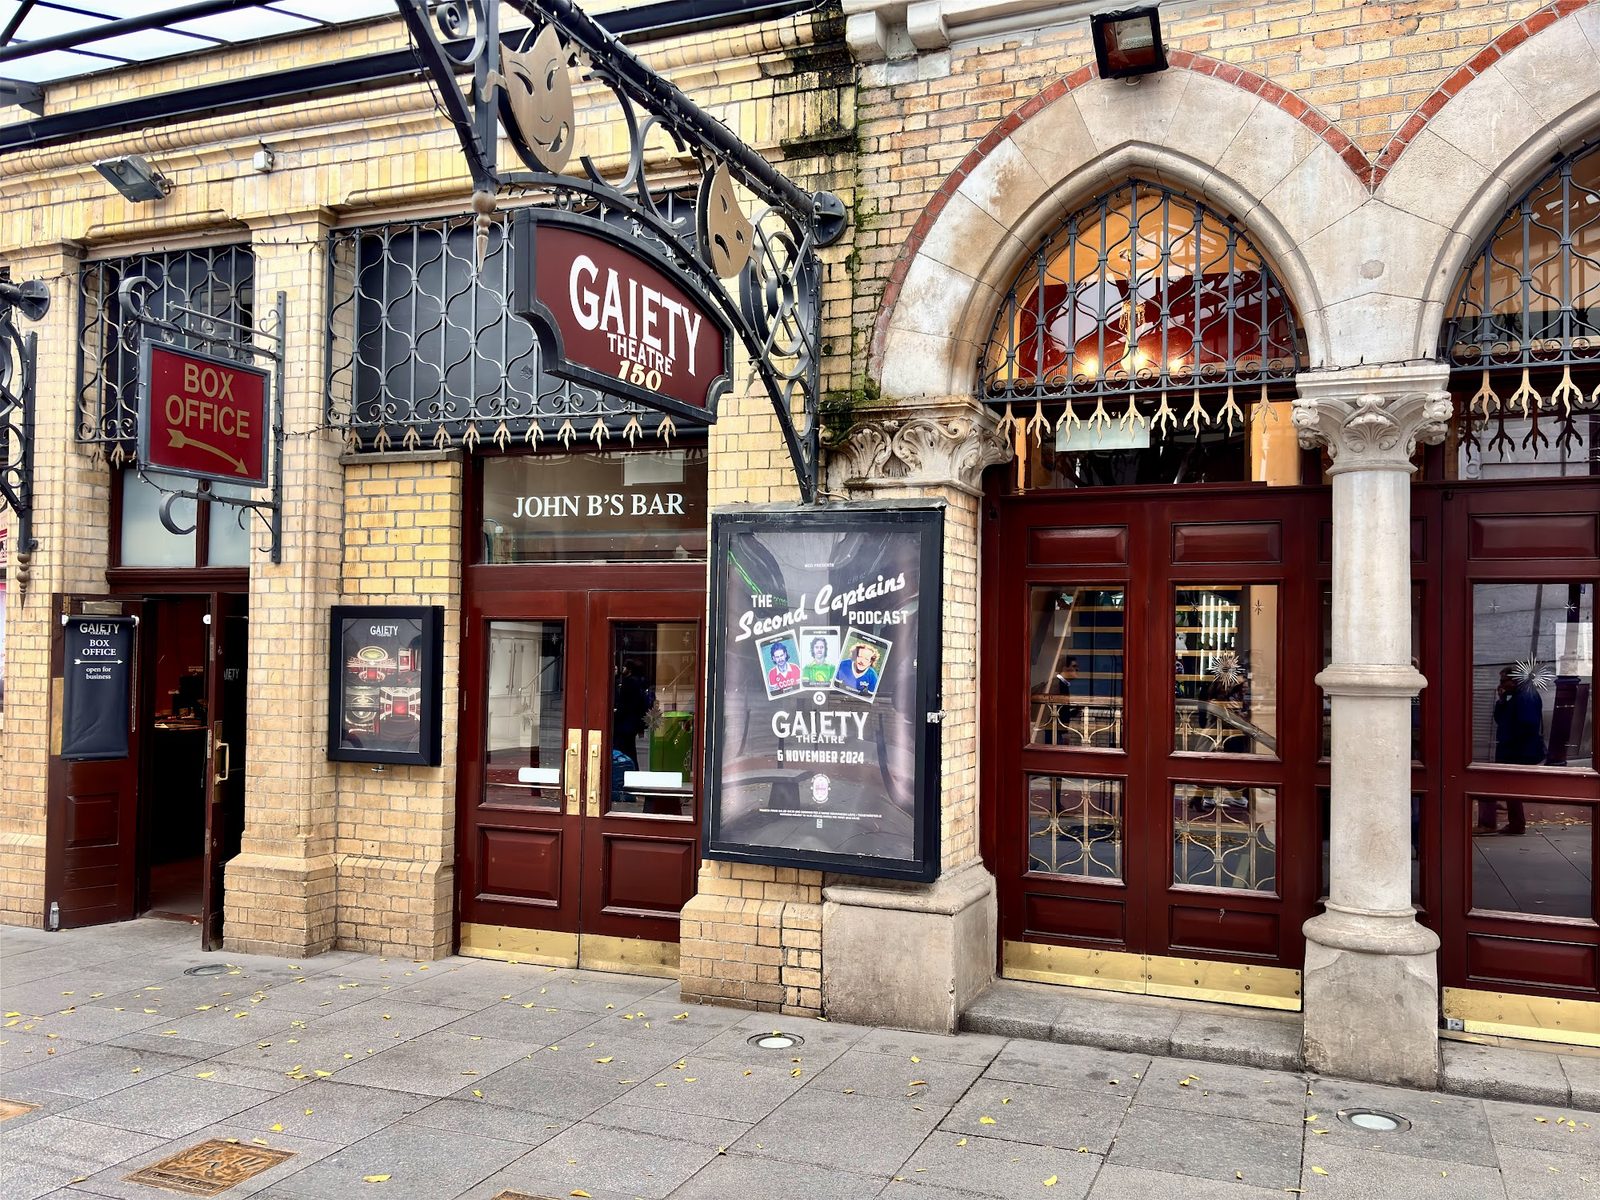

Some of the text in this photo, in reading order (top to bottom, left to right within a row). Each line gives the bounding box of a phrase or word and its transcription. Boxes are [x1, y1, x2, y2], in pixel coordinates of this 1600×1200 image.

[569, 255, 701, 377] GAIETY
[606, 333, 673, 377] THEATRE
[184, 362, 235, 402] BOX
[617, 360, 662, 392] 150
[165, 394, 250, 439] OFFICE
[513, 493, 685, 518] JOHN B'S BAR
[735, 572, 906, 642] Second Captains
[751, 595, 773, 608] THE
[848, 610, 908, 625] PODCAST
[80, 623, 120, 634] GAIETY
[370, 625, 399, 636] GAIETY
[82, 648, 117, 656] OFFICE
[89, 639, 110, 647] BOX
[771, 710, 869, 741] GAIETY
[796, 734, 845, 744] THEATRE
[777, 749, 864, 764] 6 NOVEMBER 2024
